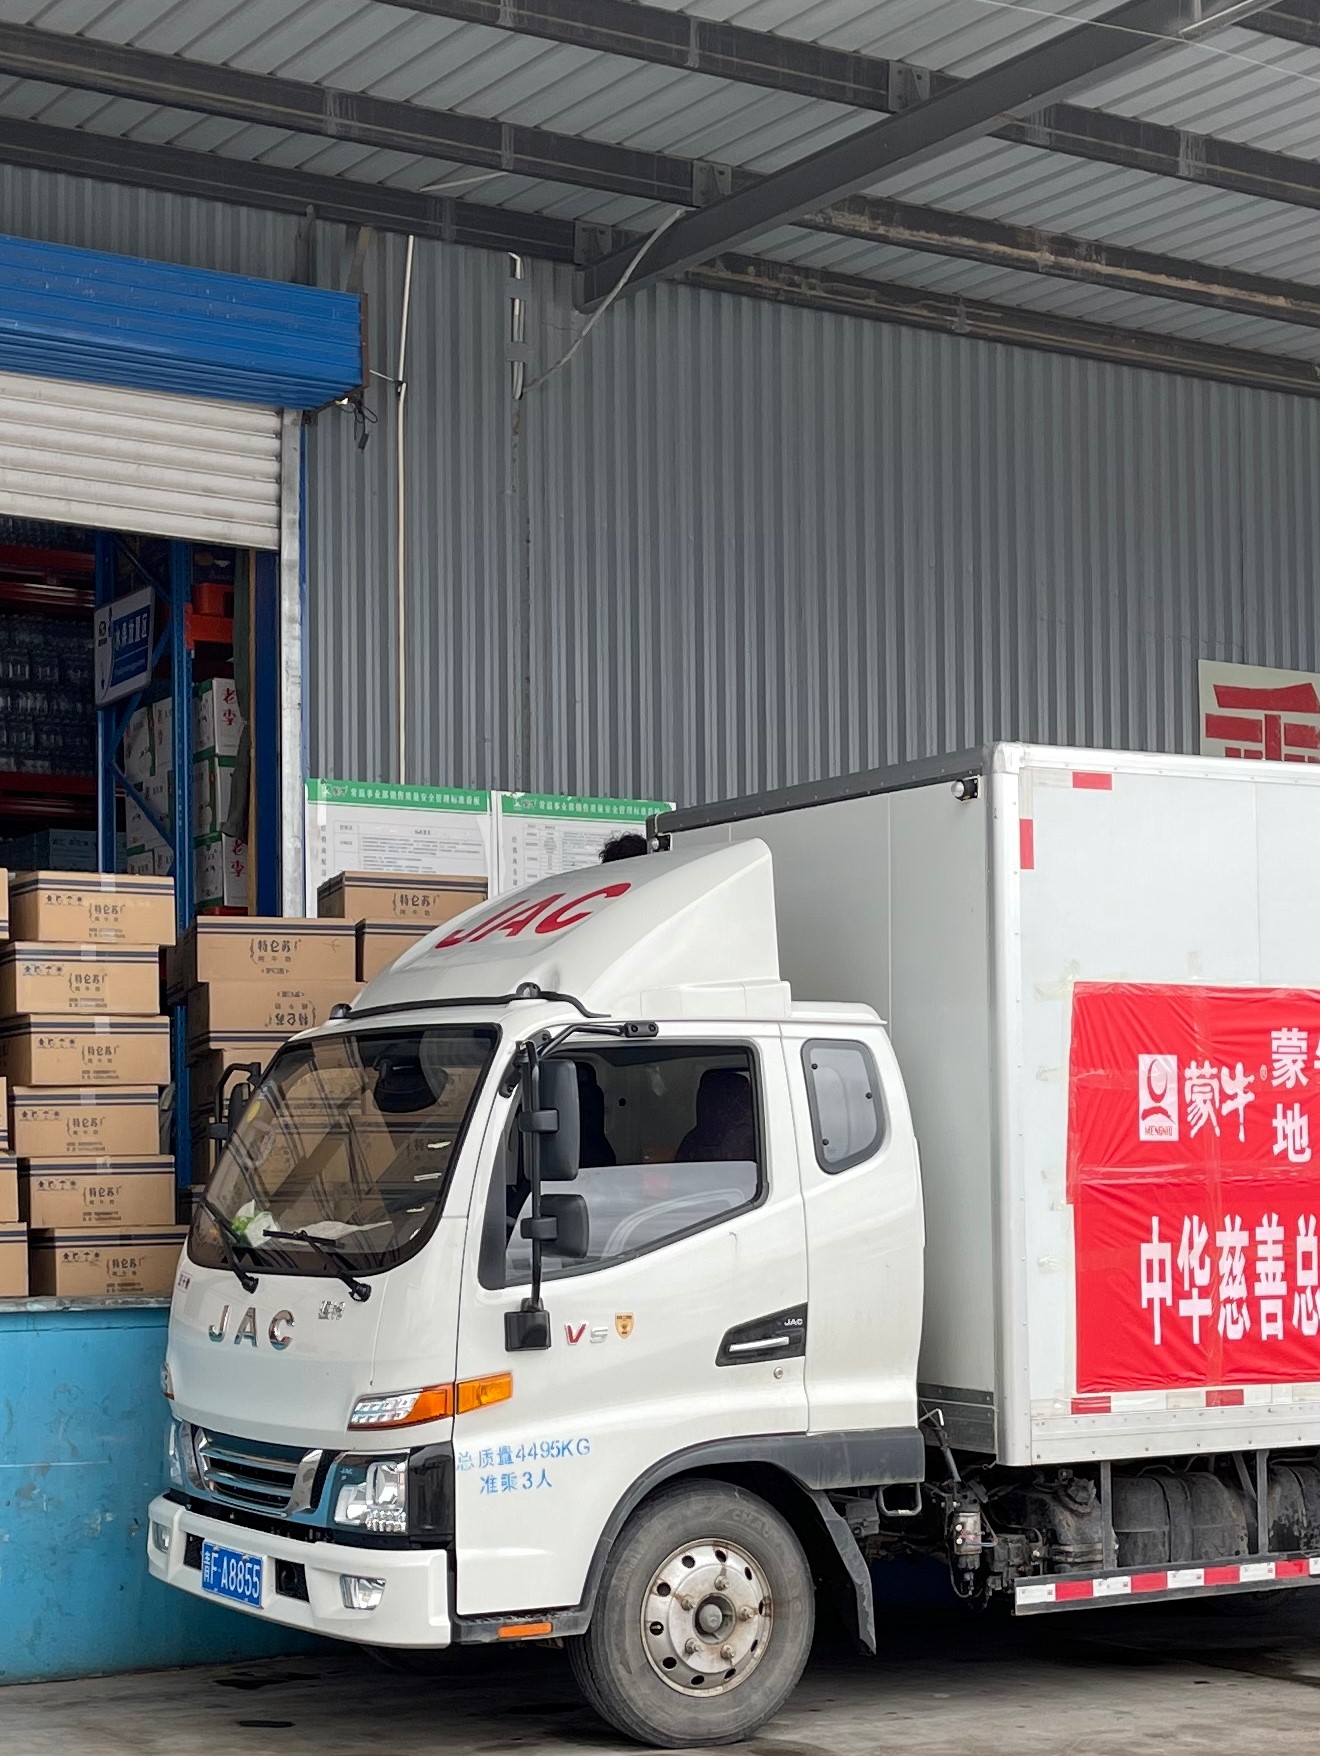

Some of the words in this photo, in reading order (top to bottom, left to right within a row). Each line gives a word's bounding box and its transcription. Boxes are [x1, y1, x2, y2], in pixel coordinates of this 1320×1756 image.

[400, 894, 431, 907] 特仑苏
[435, 882, 632, 949] JAC
[258, 940, 291, 953] 特仑苏
[1184, 1060, 1256, 1142] 蒙牛
[209, 1305, 295, 1350] JAC
[784, 1318, 803, 1326] JAC
[456, 1438, 591, 1471] 总质量4495KG
[480, 1468, 553, 1494] 准乘3人
